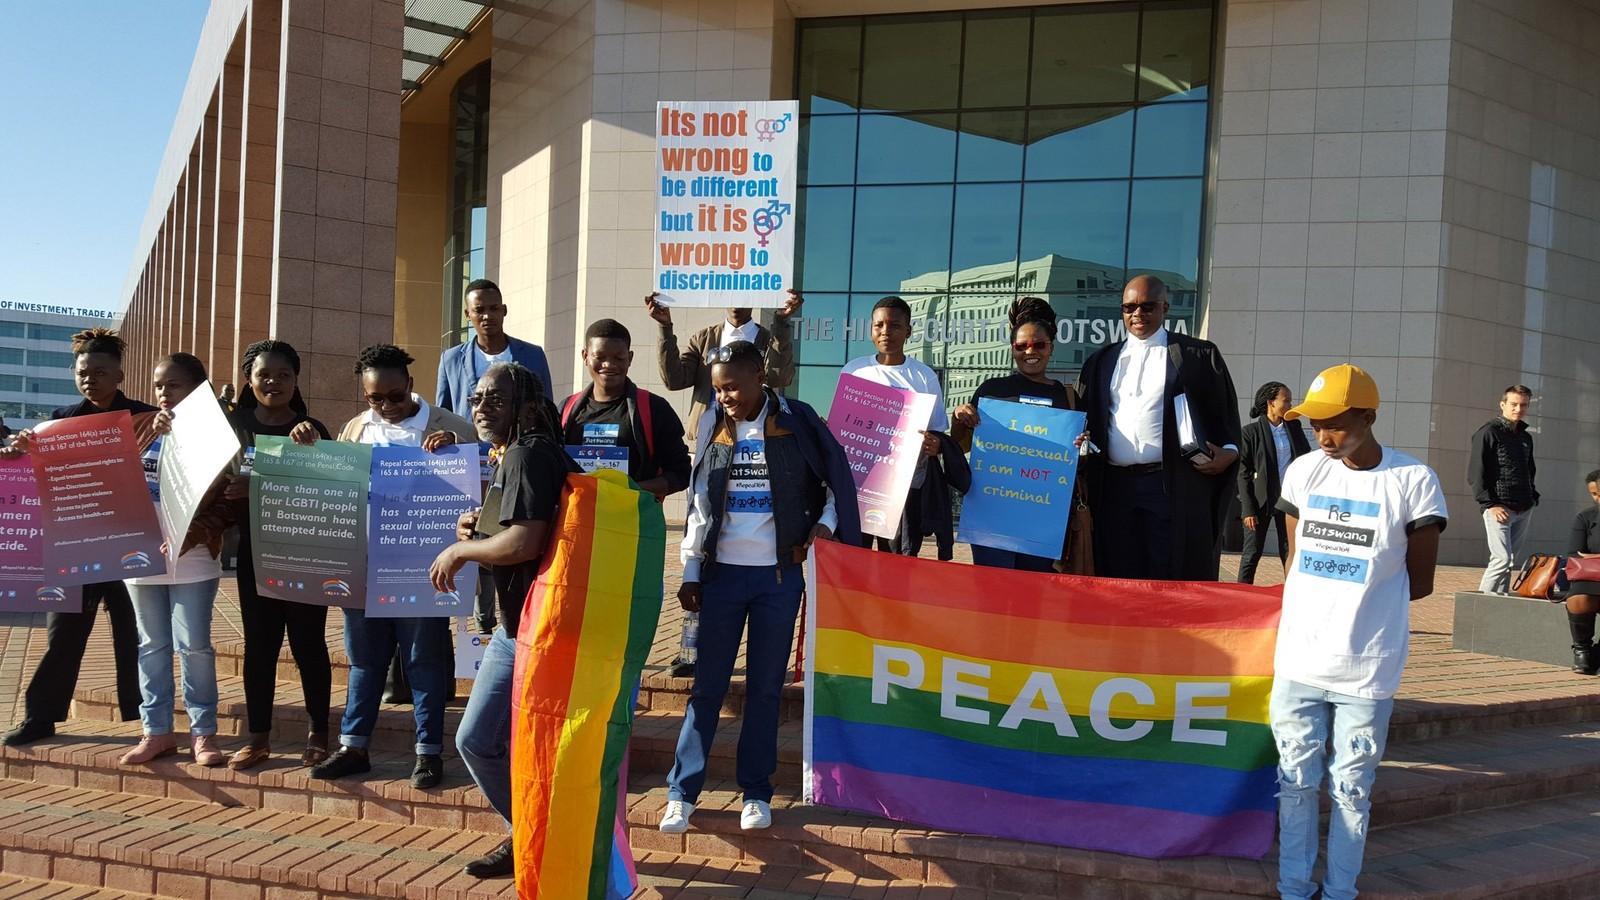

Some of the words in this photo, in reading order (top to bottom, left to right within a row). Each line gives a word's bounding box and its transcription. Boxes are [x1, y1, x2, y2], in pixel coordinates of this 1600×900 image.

[661, 108, 696, 136] Its
[703, 111, 748, 137] not
[662, 148, 748, 175] wrong
[753, 152, 773, 172] to
[661, 176, 686, 197] be
[691, 176, 778, 197] different
[661, 211, 693, 231] but
[698, 203, 717, 231] it
[723, 203, 747, 232] is
[660, 242, 745, 270] wrong
[750, 248, 769, 266] to
[659, 270, 782, 291] discriminate
[1, 301, 12, 309] OF
[77, 308, 105, 318] TRADE
[790, 317, 833, 341] THE
[842, 318, 872, 342] HI
[1056, 318, 1188, 344] OTSWA
[844, 385, 863, 396] Repeal
[864, 391, 883, 402] Section
[843, 393, 853, 401] 165
[860, 399, 871, 407] 167
[878, 404, 888, 412] the
[594, 427, 606, 436] Re
[853, 416, 864, 427] in
[865, 420, 874, 429] 3
[875, 423, 905, 438] lesbia
[1008, 419, 1017, 430] I
[1023, 424, 1048, 436] am
[36, 436, 56, 445] Repeal
[56, 432, 78, 440] Section
[39, 444, 50, 452] 165
[56, 442, 67, 450] 167
[87, 438, 103, 446] Penal
[104, 436, 121, 444] Code
[840, 428, 881, 447] women
[286, 450, 310, 458] Section
[741, 446, 760, 460] Re
[844, 444, 897, 465] ttempte
[975, 436, 1074, 464] homosexual,
[317, 462, 335, 470] Penal
[336, 463, 354, 471] Code
[450, 467, 466, 475] Code
[732, 468, 768, 476] atswa
[974, 459, 983, 471] I
[989, 464, 1013, 476] am
[1020, 467, 1052, 480] NOT
[1058, 476, 1068, 486] a
[261, 481, 290, 493] More
[295, 484, 319, 495] than
[324, 489, 343, 497] one
[348, 489, 358, 498] in
[412, 494, 471, 502] transwomen
[984, 486, 1051, 504] criminal
[10, 495, 17, 504] 3
[261, 495, 283, 506] four
[285, 497, 319, 508] LGBTI
[321, 502, 358, 513] people
[261, 508, 271, 518] in
[277, 510, 327, 523] Botswana
[333, 515, 358, 526] have
[381, 507, 400, 517] has
[407, 506, 471, 518] experienced
[1328, 504, 1351, 522] Re
[0, 526, 44, 538] tempt
[262, 524, 315, 536] attempted
[318, 528, 356, 539] suicide.
[380, 521, 412, 530] sexual
[416, 521, 457, 530] violence
[1307, 522, 1368, 543] Batswana
[0, 541, 28, 550] cide.
[380, 536, 398, 544] the
[399, 535, 417, 544] last
[419, 536, 443, 547] year.
[872, 644, 1232, 746] PEACE
